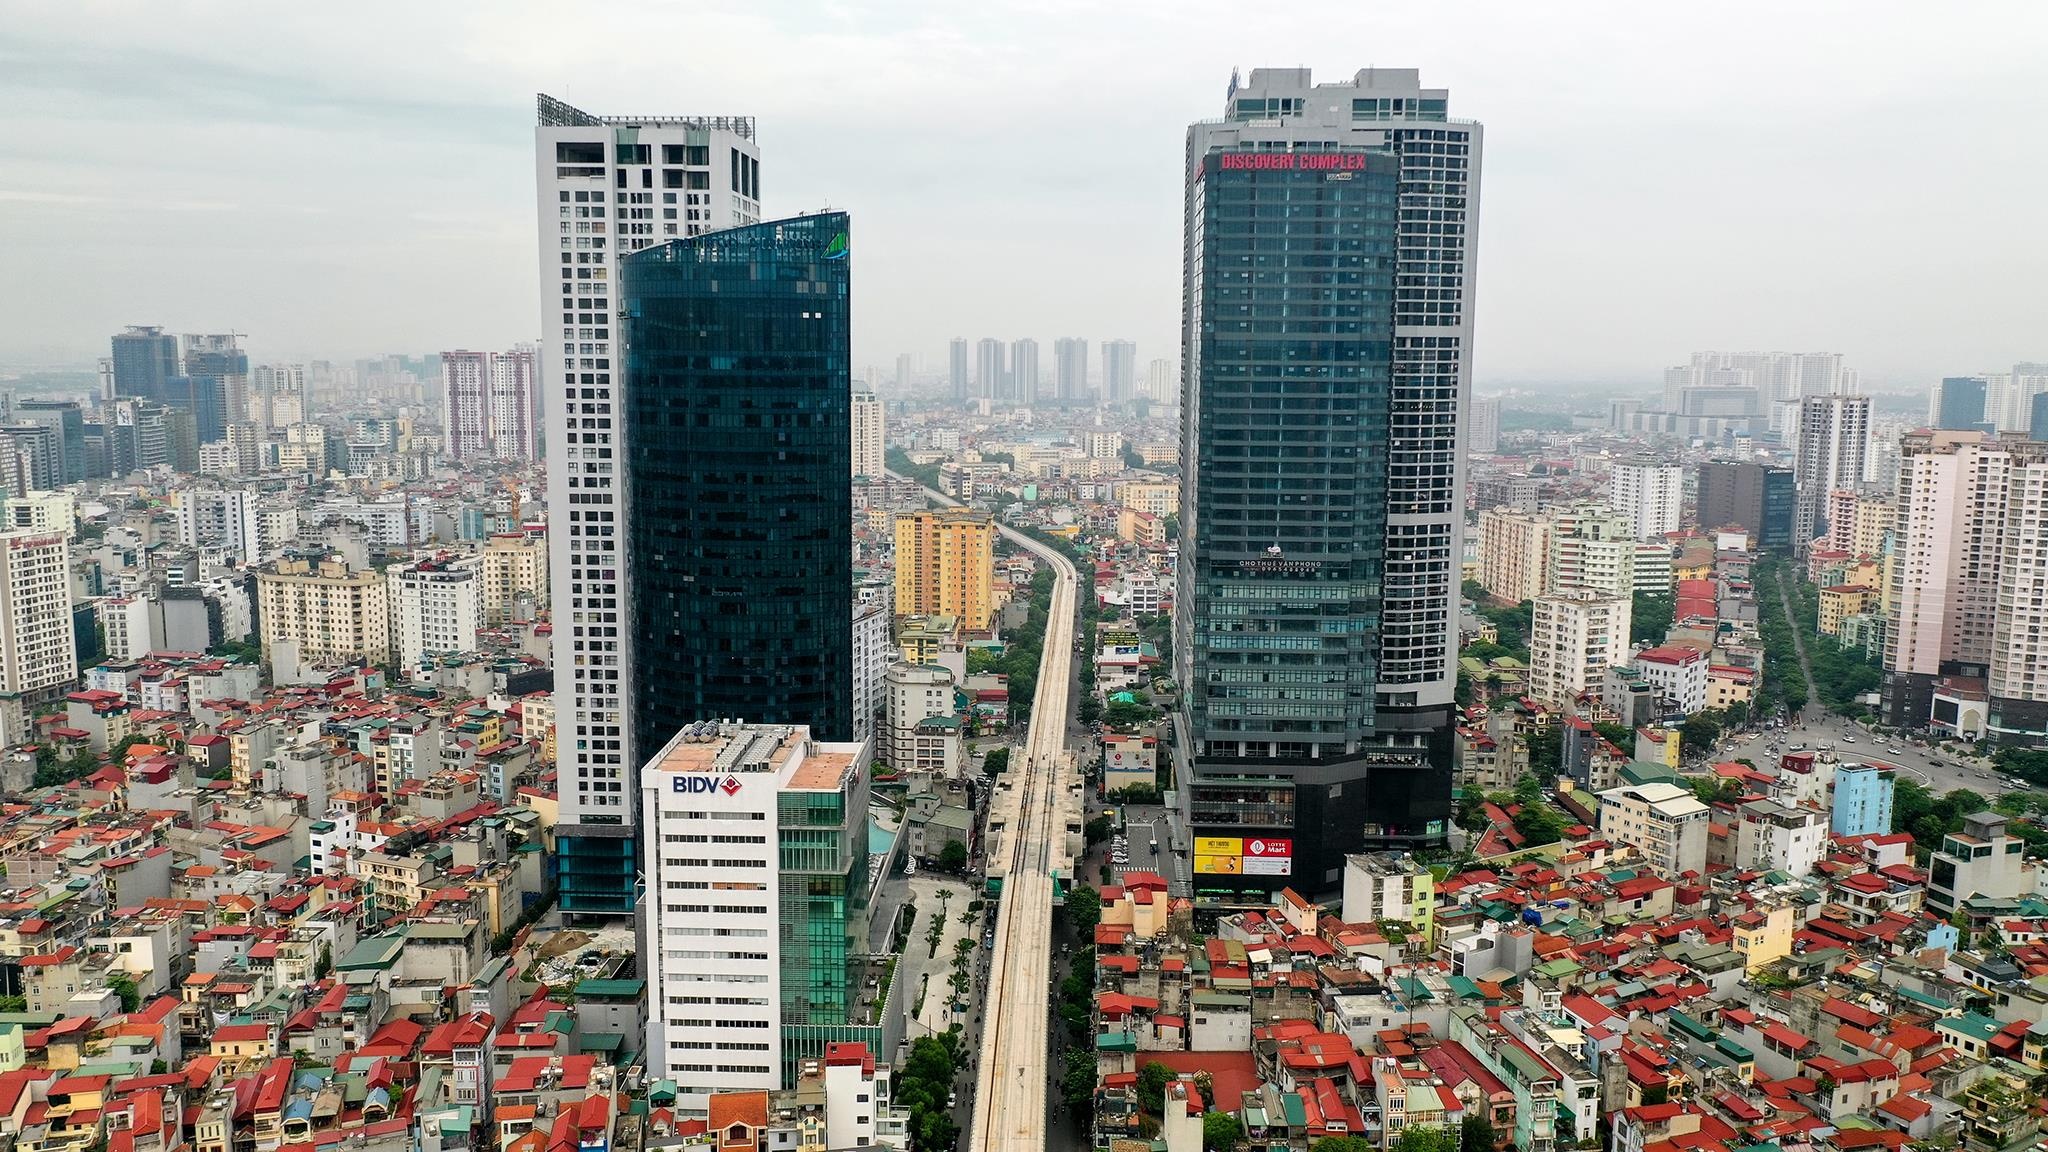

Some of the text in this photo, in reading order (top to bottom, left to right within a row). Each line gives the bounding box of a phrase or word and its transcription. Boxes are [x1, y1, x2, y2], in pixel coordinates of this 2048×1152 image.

[1222, 154, 1295, 169] DISCOVERY
[1300, 154, 1365, 169] COMPLEX
[673, 776, 720, 793] BIDV
